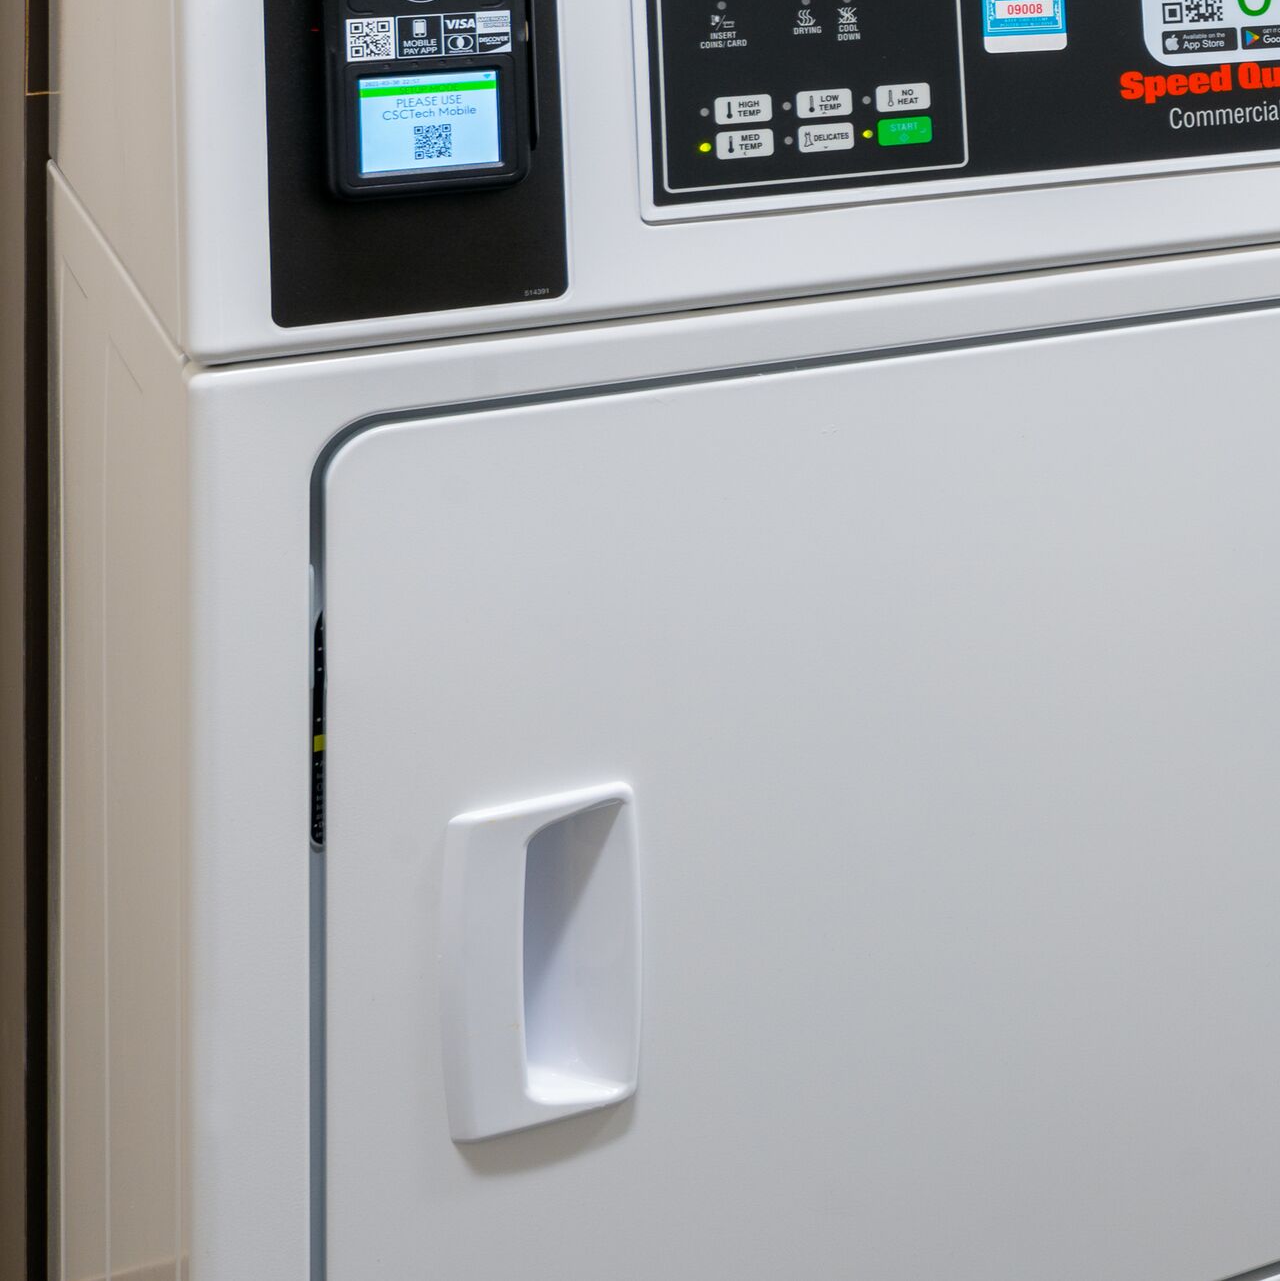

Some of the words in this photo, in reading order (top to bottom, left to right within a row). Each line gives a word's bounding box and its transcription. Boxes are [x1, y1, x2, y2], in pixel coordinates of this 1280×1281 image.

[1007, 4, 1043, 15] 09008
[445, 18, 476, 29] VISA
[838, 24, 859, 32] COOL
[793, 25, 822, 35] DRYING
[710, 31, 736, 40] INSERT
[837, 32, 861, 42] DOWN
[403, 38, 438, 48] MOBILE
[1183, 40, 1200, 50] App
[1202, 39, 1225, 48] Store
[404, 47, 419, 56] PAY
[420, 46, 438, 55] APP
[1119, 65, 1232, 104] Speed
[902, 89, 914, 97] NO
[397, 96, 437, 108] PLEASE
[441, 94, 462, 105] USE
[820, 94, 839, 103] LOW
[898, 97, 919, 105] HEAT
[738, 100, 760, 108] HIGH
[819, 103, 842, 112] TEMP
[382, 108, 436, 121] CSCTech
[439, 106, 477, 117] Mobile
[737, 109, 762, 118] TEMP
[890, 121, 918, 132] START
[740, 133, 760, 143] MED
[813, 132, 850, 143] DELICATES
[739, 142, 763, 151] TEMP
